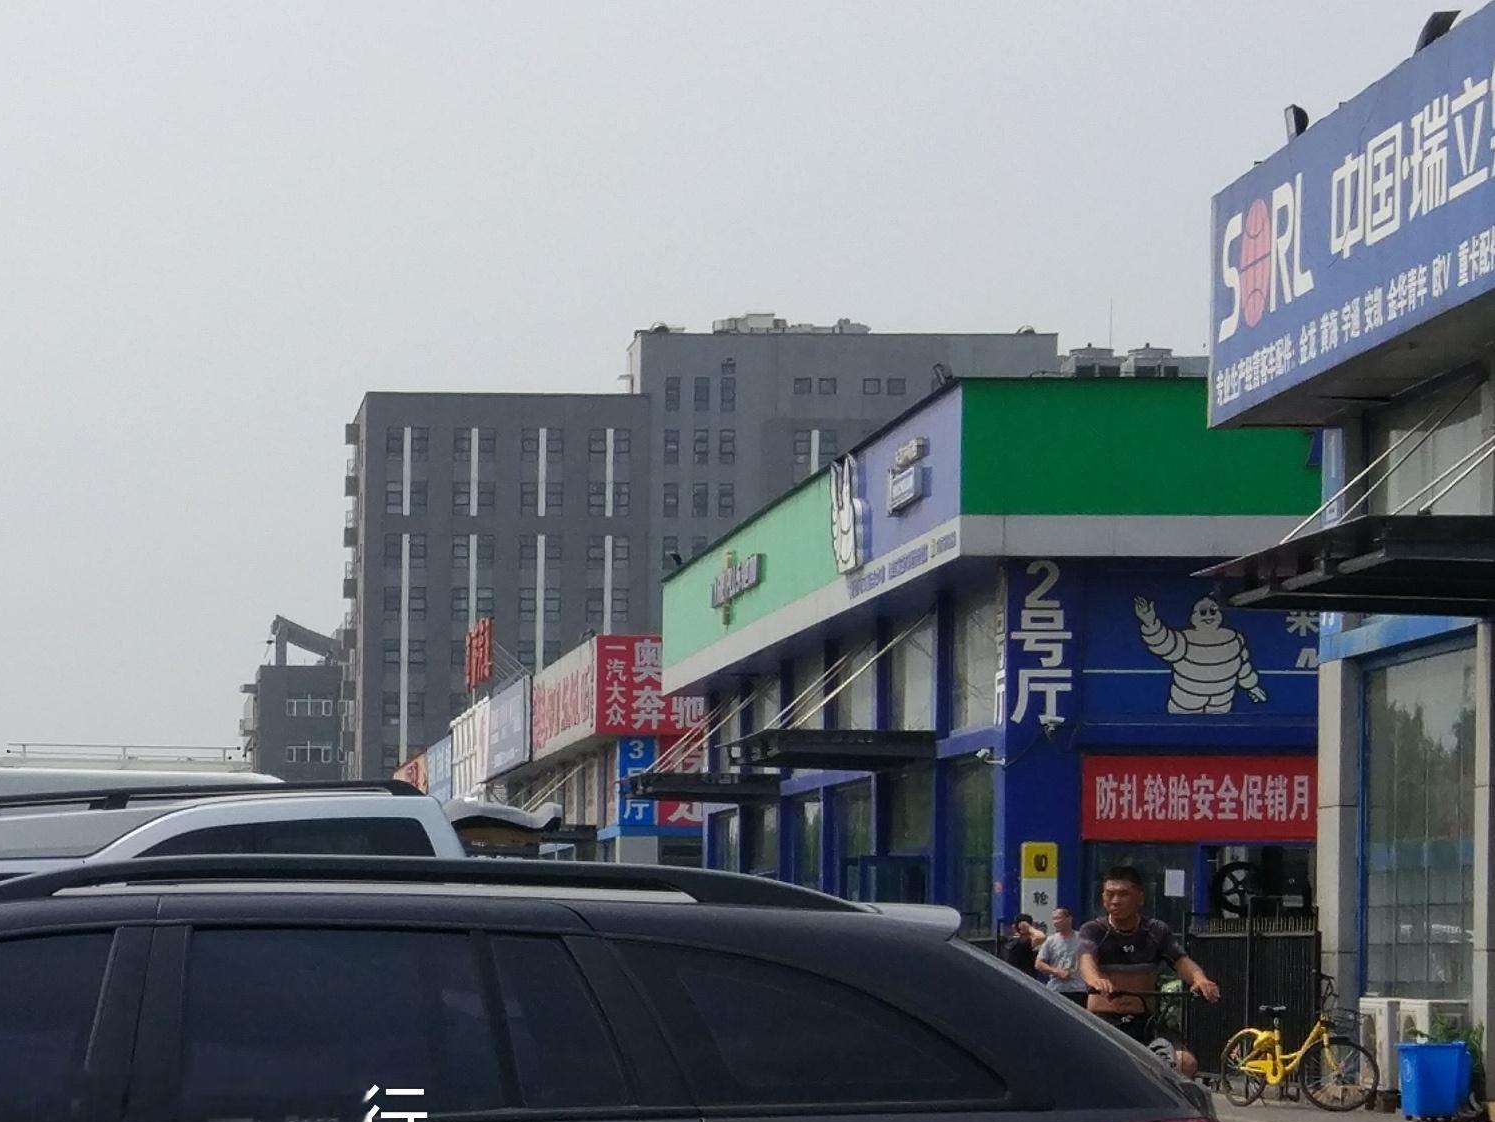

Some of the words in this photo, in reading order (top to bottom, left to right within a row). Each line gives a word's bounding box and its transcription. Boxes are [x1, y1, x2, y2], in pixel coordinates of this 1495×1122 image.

[1330, 64, 1495, 259] 中国·瑞立
[605, 644, 627, 726] 一汽大众
[1010, 560, 1072, 724] 2号厅
[1095, 773, 1309, 821] 防扎轮胎安全促销月
